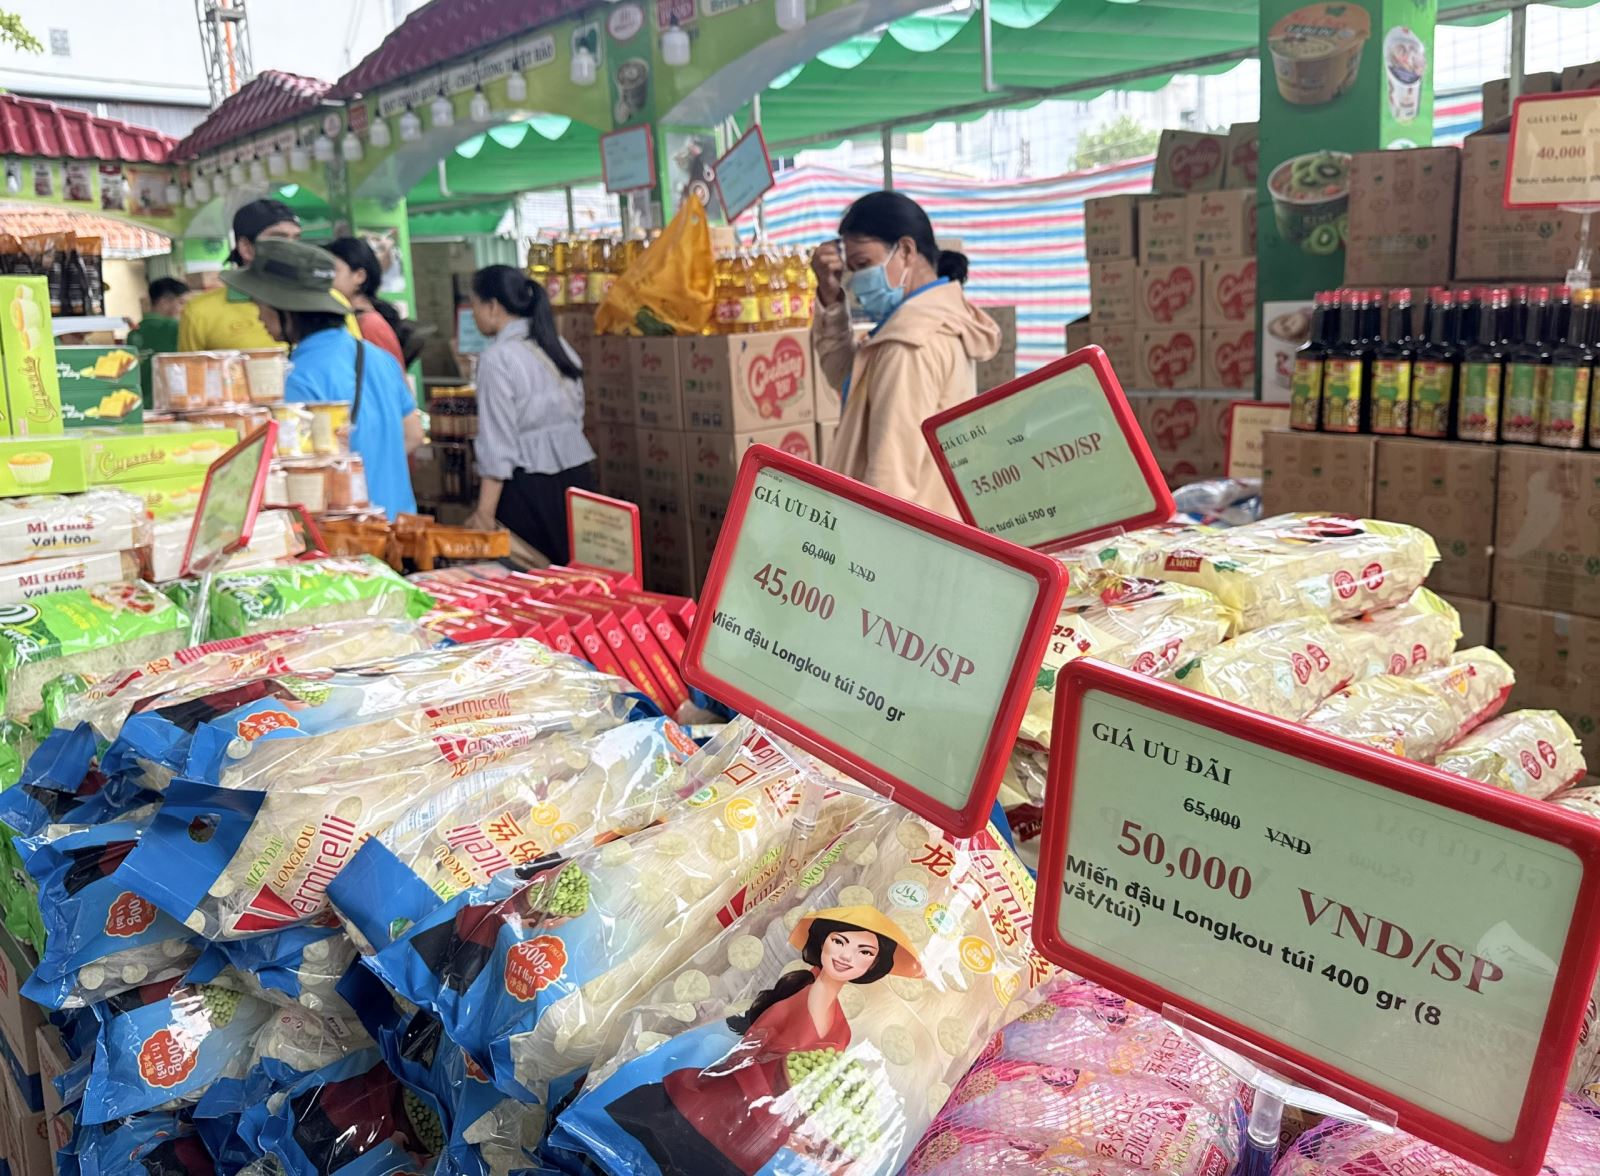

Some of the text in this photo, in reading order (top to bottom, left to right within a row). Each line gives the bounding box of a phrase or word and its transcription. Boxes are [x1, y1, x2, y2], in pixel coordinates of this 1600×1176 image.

[1536, 145, 1587, 161] 40,000
[971, 432, 1103, 496] 35,000 VND/SP
[754, 484, 838, 533] GIÁ ƯU ĐÃI
[1015, 515, 1028, 527] túi
[1027, 508, 1046, 522] 500
[1046, 505, 1057, 519] gr
[18, 573, 39, 588] Mì
[801, 540, 877, 583] 60,000 VND
[753, 562, 976, 686] 45,000 VND/SP
[711, 608, 906, 724] Miến đậu Longkou túi 500 gr
[1092, 721, 1233, 786] GIÁ ƯU ĐÃI
[1183, 797, 1313, 856] 65,000 VND
[272, 824, 316, 889] LONGKOU
[1062, 880, 1142, 928] vắt/túi)
[1117, 819, 1252, 900] 50,000
[1297, 886, 1505, 995] VND/SP
[517, 946, 552, 973] 500g
[1065, 853, 1119, 891] Miến
[1125, 880, 1167, 912] đậu
[1171, 898, 1275, 957] Longkou
[1280, 945, 1316, 975] túi
[1320, 961, 1370, 997] 400
[1375, 988, 1408, 1012] gr
[1414, 1000, 1443, 1027] (8
[164, 1036, 184, 1077] 500g
